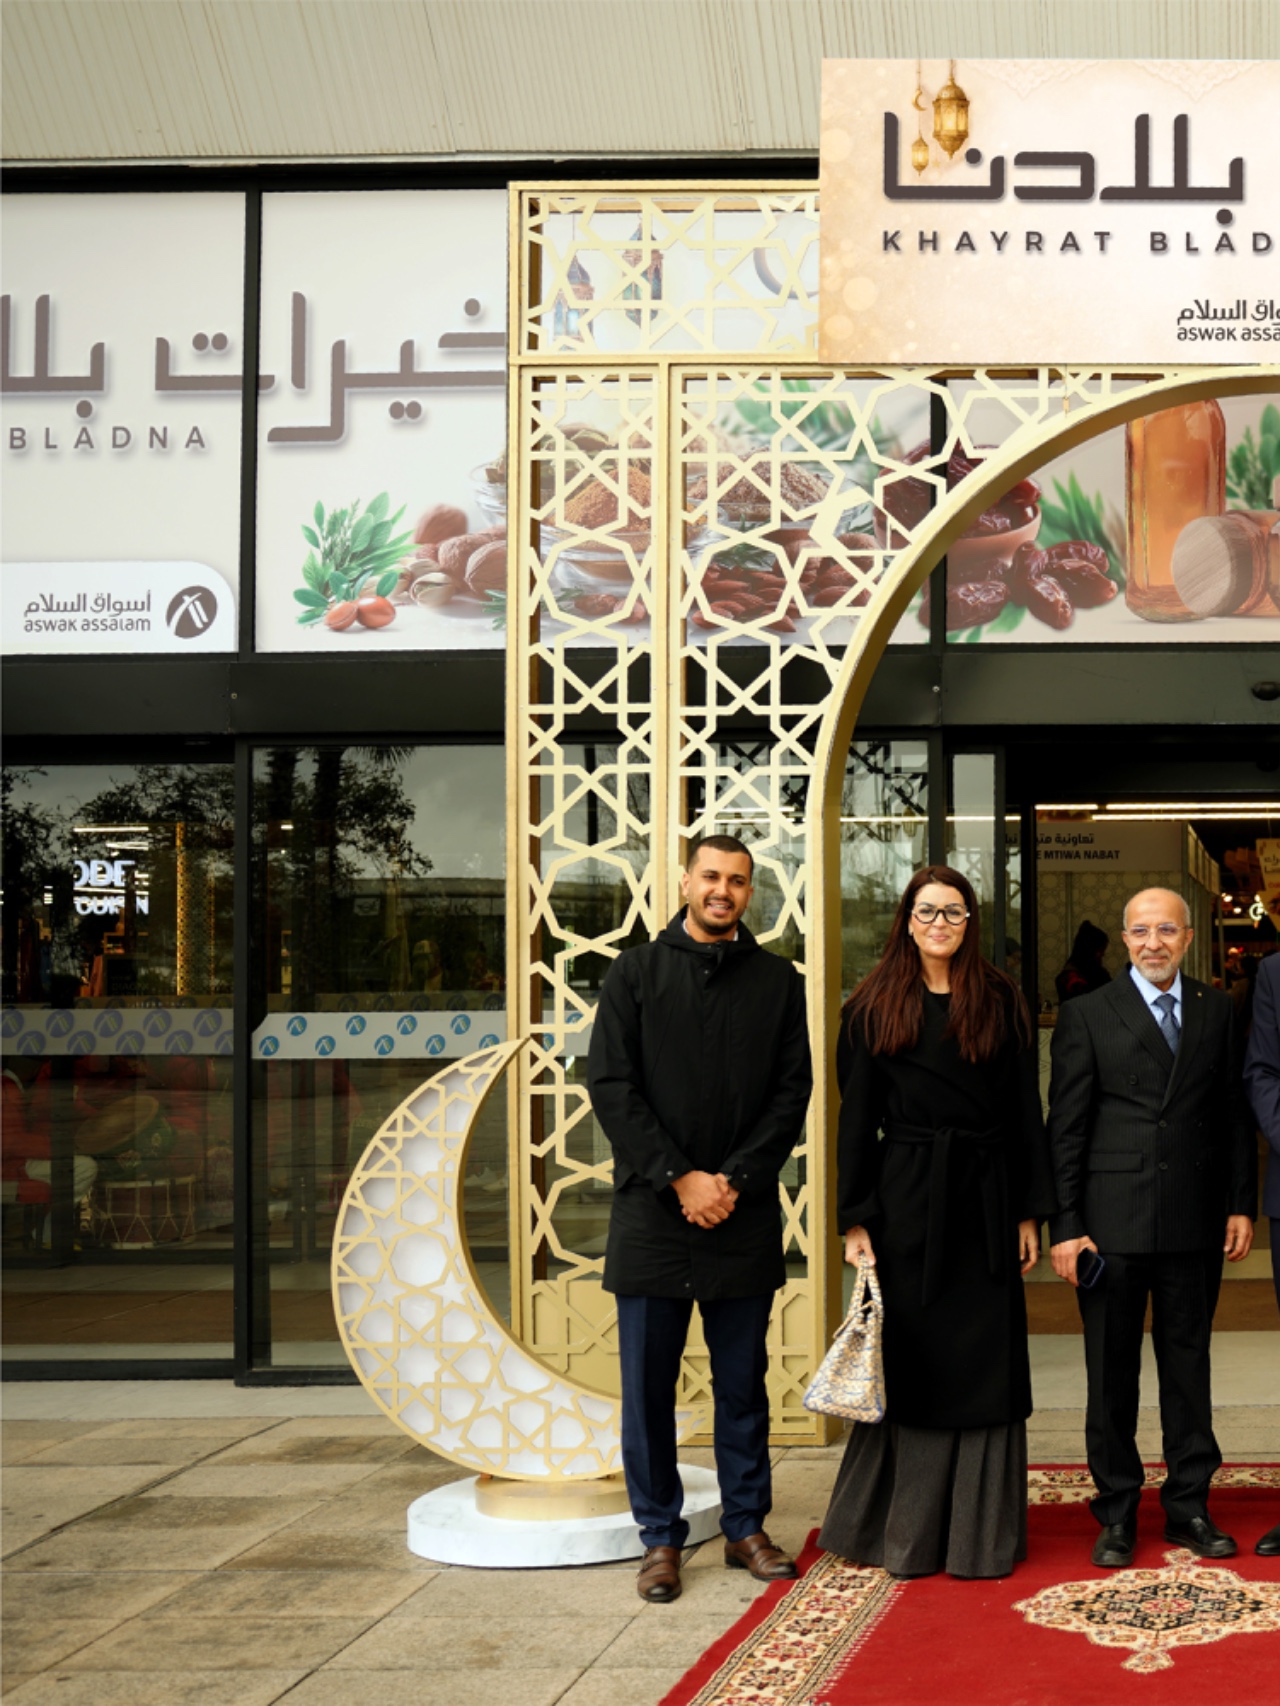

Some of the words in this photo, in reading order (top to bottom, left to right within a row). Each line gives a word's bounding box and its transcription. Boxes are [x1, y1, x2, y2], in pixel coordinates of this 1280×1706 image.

[883, 230, 1111, 253] KHAYRAT
[1177, 298, 1247, 326] السلام
[1177, 326, 1237, 342] aswak
[8, 426, 206, 450] BLADNA
[24, 592, 87, 618] السلام
[89, 590, 152, 618] أسواق
[81, 617, 152, 633] assalam
[1044, 850, 1081, 860] MTIWA
[1084, 849, 1120, 860] NABAT
